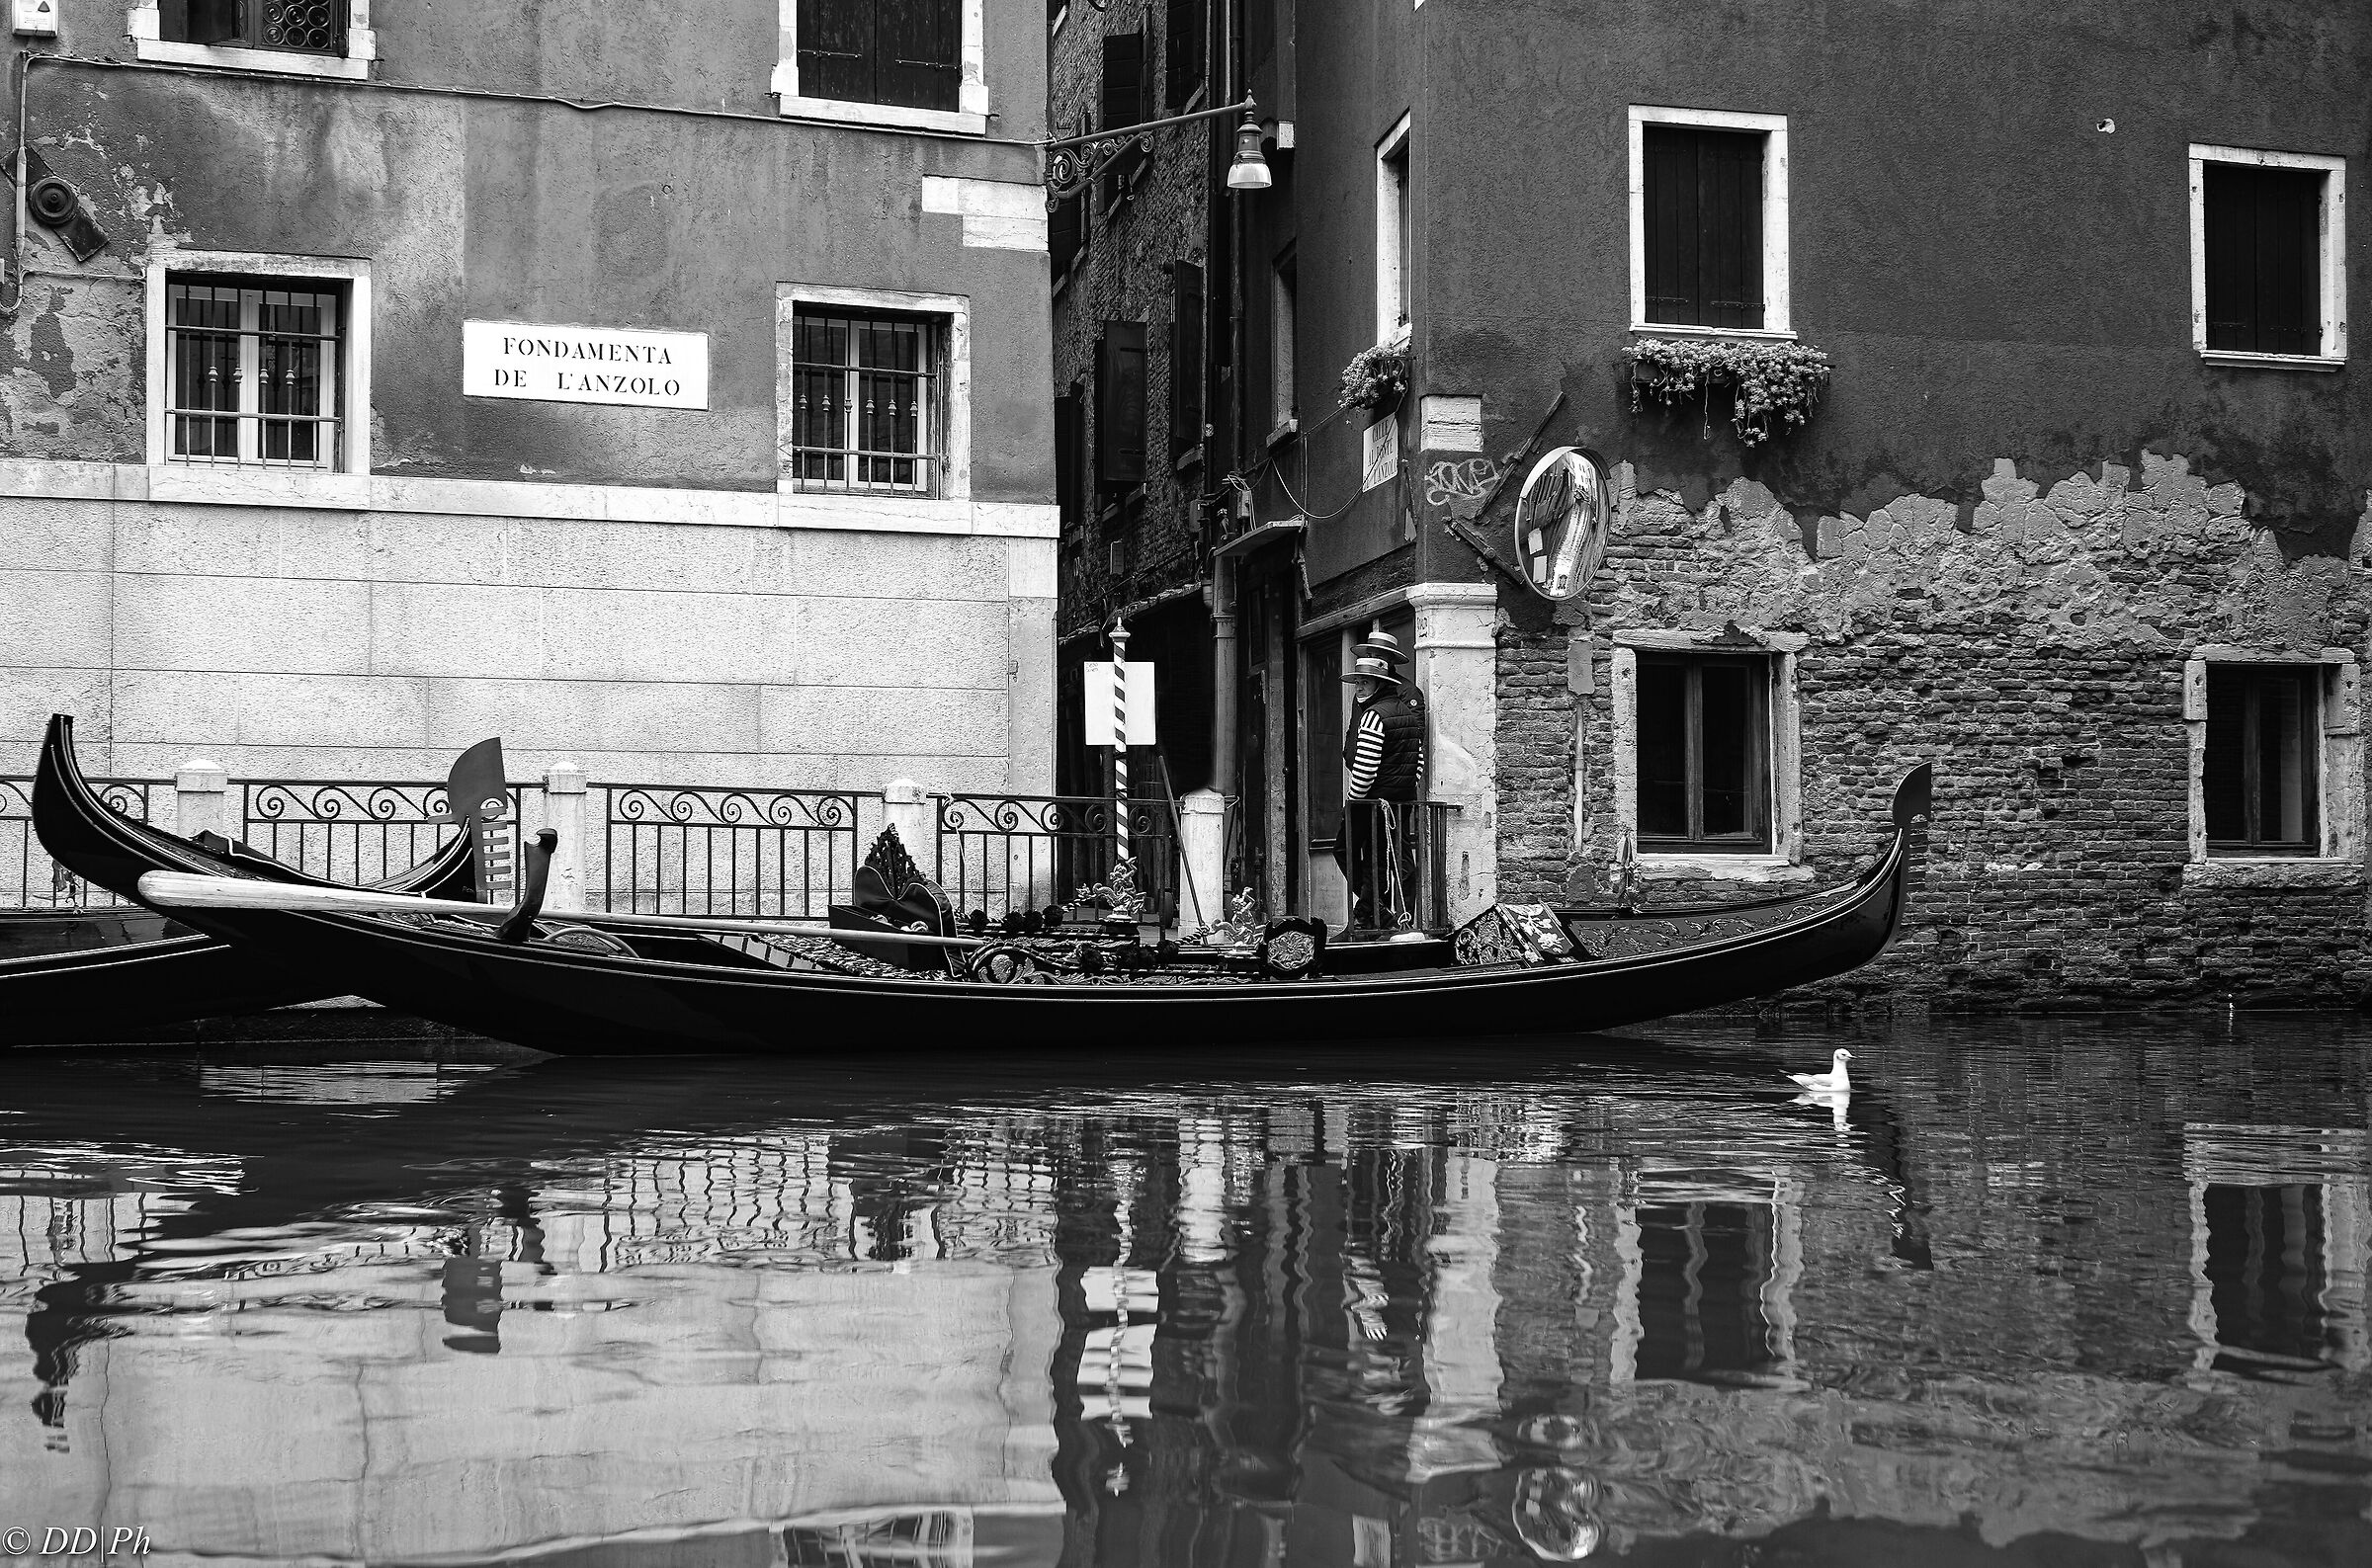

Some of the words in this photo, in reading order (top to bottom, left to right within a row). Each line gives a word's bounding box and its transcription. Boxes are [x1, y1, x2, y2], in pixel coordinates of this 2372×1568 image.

[504, 337, 672, 365] FONDAMENTA
[494, 369, 527, 387] DE
[557, 371, 680, 396] L'ANZOLO
